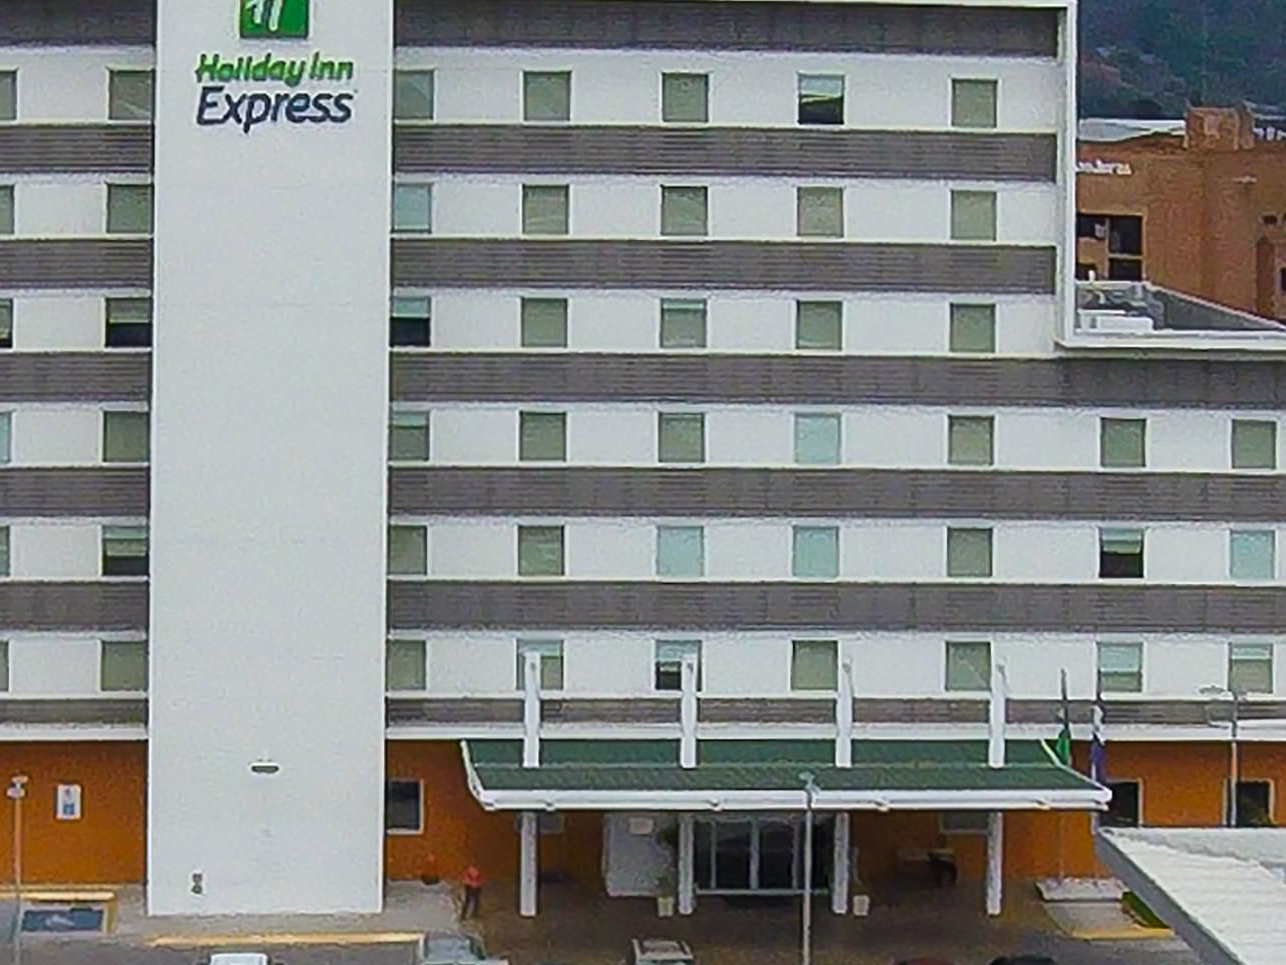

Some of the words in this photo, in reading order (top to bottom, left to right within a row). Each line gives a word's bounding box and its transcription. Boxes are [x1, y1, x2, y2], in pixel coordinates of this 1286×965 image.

[195, 52, 305, 87] Holiday
[309, 51, 354, 81] Inn
[196, 86, 354, 134] Express
